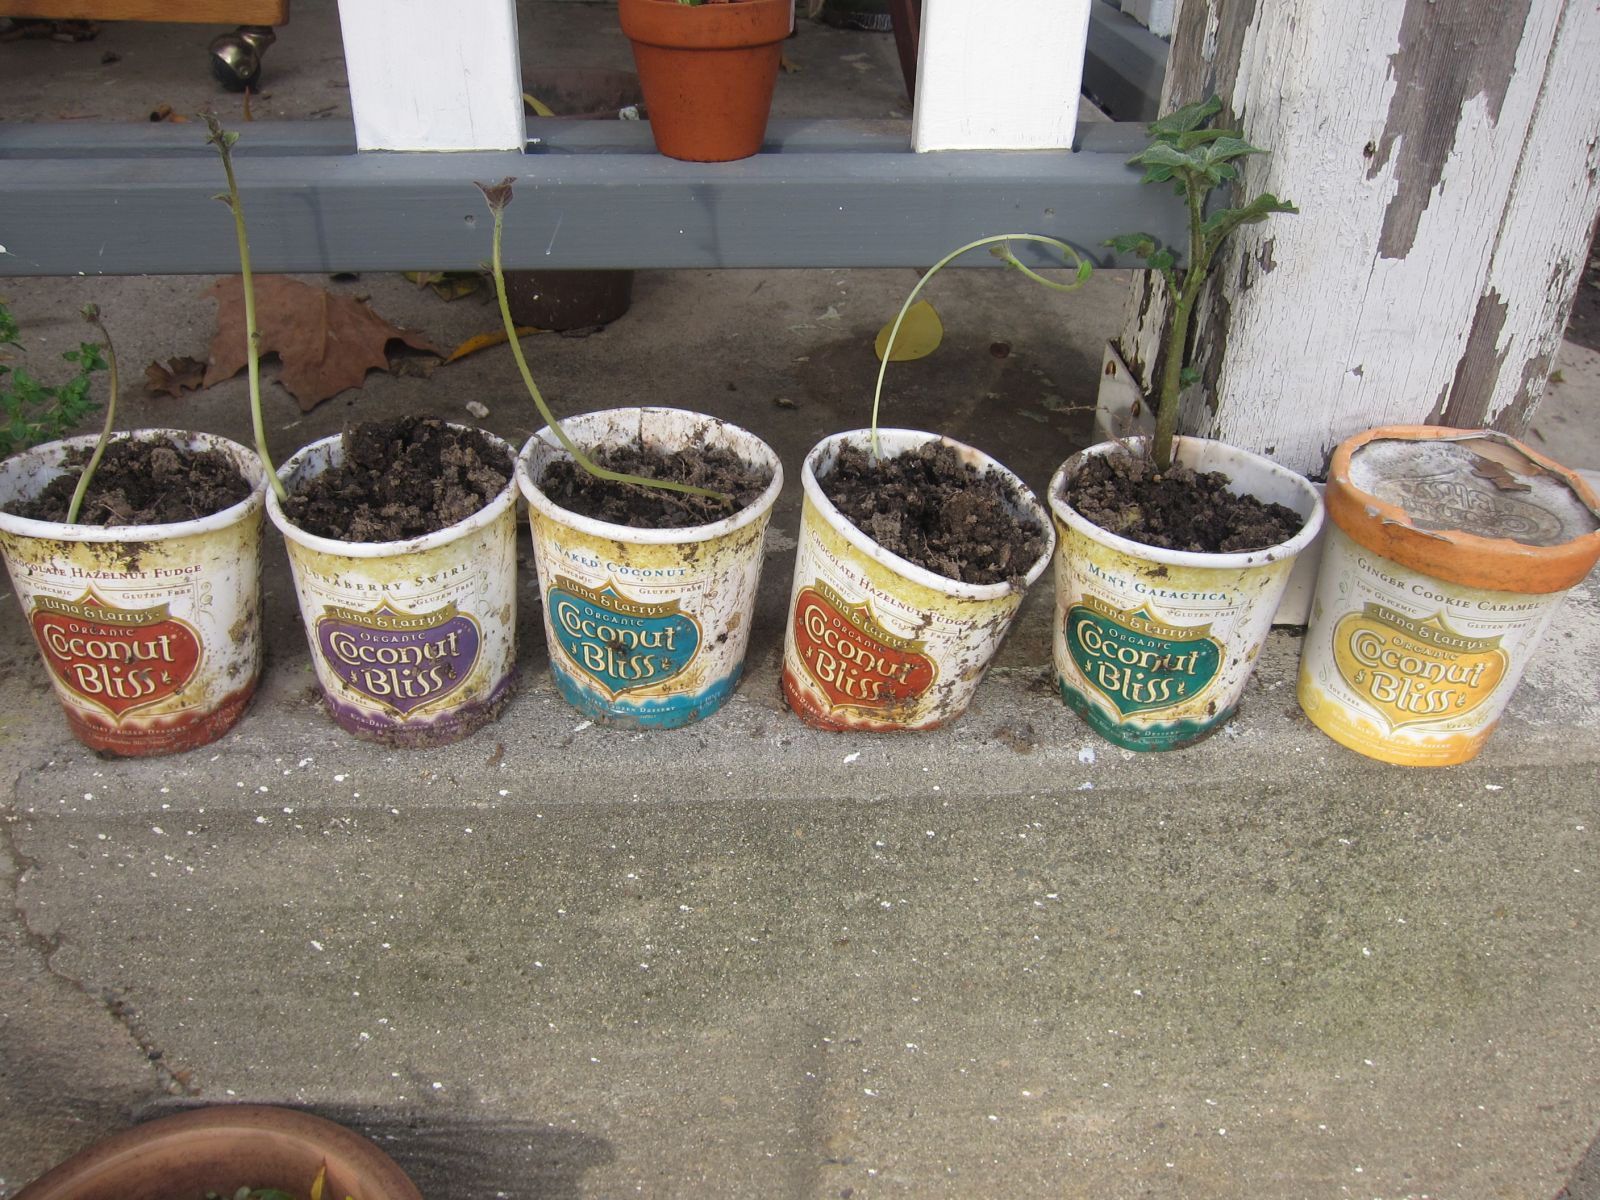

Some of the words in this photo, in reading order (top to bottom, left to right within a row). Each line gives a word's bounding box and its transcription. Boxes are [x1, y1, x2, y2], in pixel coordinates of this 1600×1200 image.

[154, 564, 202, 578] FUDGE
[415, 563, 469, 587] SWIRL
[554, 542, 599, 568] NAKED
[606, 562, 687, 578] COCONUT
[565, 579, 597, 602] Luna
[601, 596, 611, 607] &
[614, 600, 663, 616] Larry's
[1088, 563, 1127, 588] MINT
[1134, 582, 1228, 600] GALACTICA
[1357, 557, 1405, 590] GINGER
[1411, 585, 1471, 608] COOKIE
[1477, 601, 1541, 612] CARAMEL
[44, 598, 80, 616] Luna
[84, 607, 95, 618] &
[99, 609, 153, 622] Larry's
[336, 608, 372, 624] Luna
[376, 617, 388, 628] &
[392, 612, 444, 628] Larry's
[824, 586, 850, 617] Luna
[851, 614, 861, 625] &
[1094, 600, 1126, 623] Luna
[1130, 617, 1140, 628] &
[1144, 621, 1194, 639] Larry's
[43, 624, 175, 661] Coconut
[557, 601, 676, 651] Coconut
[804, 604, 915, 685] Coconut
[1378, 607, 1414, 631] Luna
[1419, 626, 1430, 639] &
[1433, 631, 1484, 650] Larry's
[329, 630, 462, 666] Coconut
[581, 642, 657, 680] Bliss
[1077, 619, 1200, 675] Coconut
[1350, 629, 1486, 688] Coconut
[73, 663, 155, 698] Bliss
[362, 666, 444, 699] Bliss
[816, 649, 886, 701] Bliss
[1098, 660, 1176, 703] Bliss
[1371, 671, 1457, 713] Bliss
